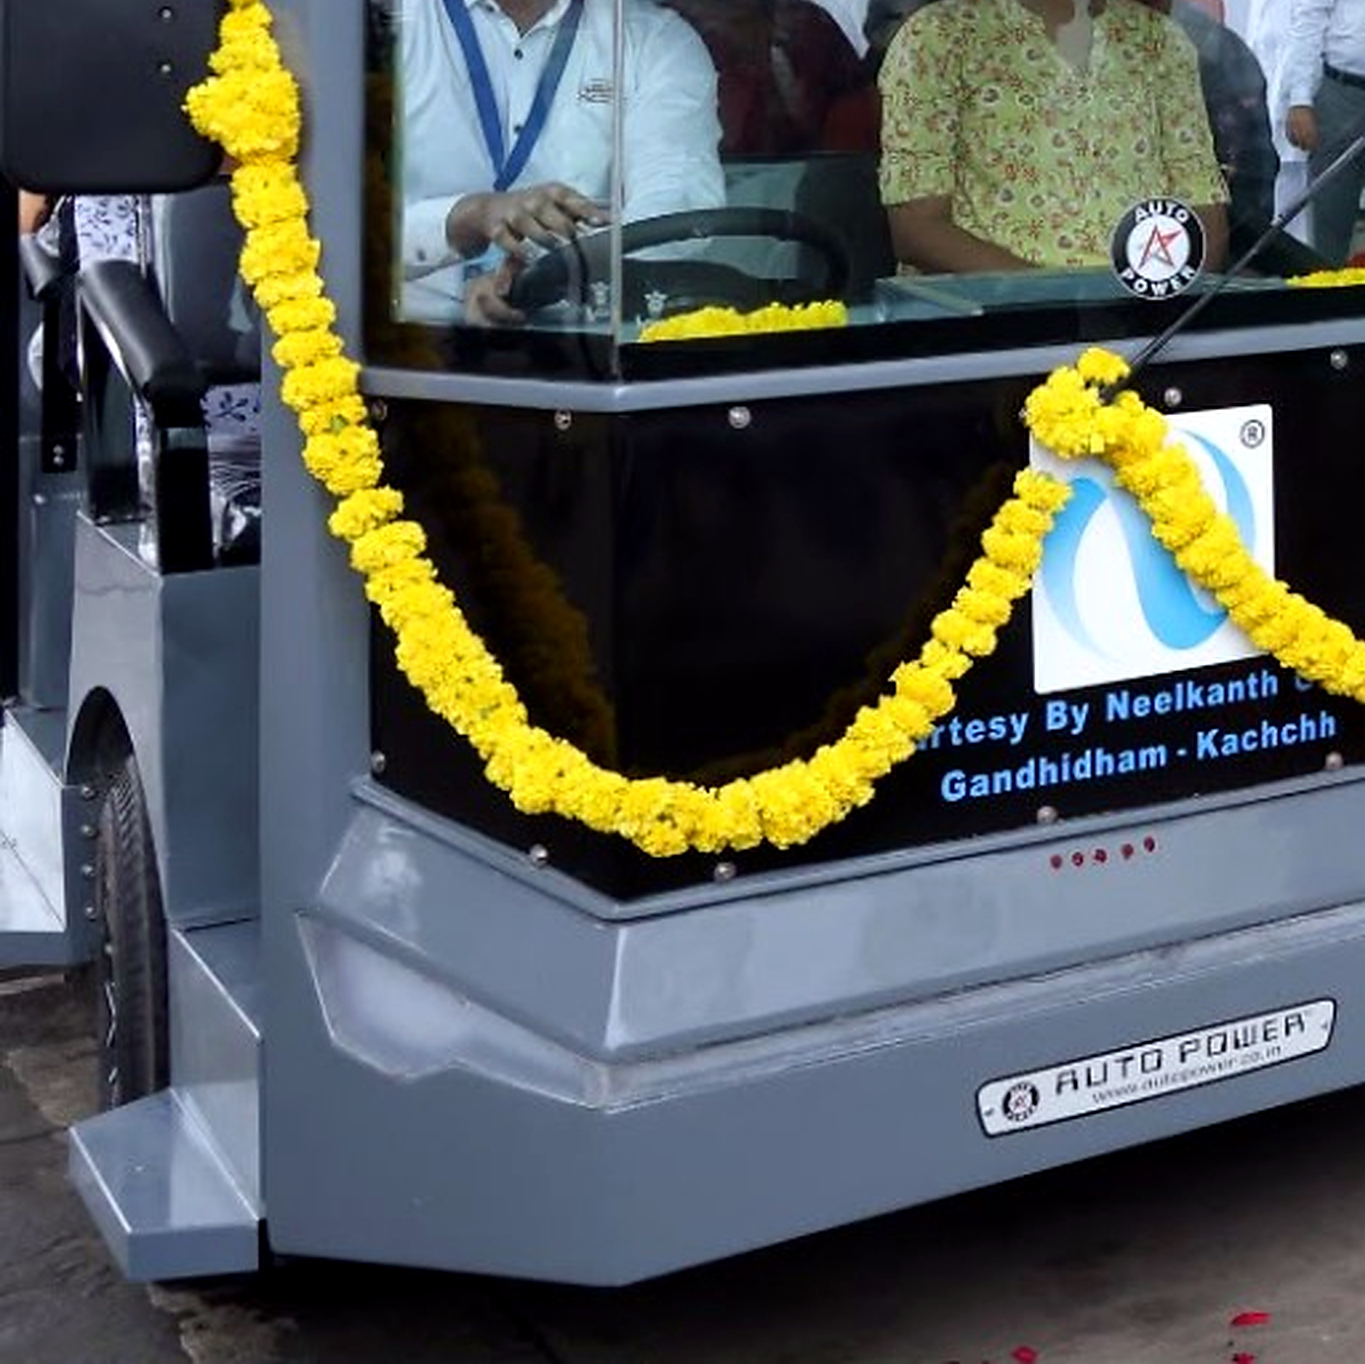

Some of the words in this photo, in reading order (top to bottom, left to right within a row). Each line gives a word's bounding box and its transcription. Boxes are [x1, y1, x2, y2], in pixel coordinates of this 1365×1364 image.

[1135, 200, 1189, 223] AUTO
[1121, 266, 1196, 296] POWER
[918, 712, 1029, 750] rtesy
[1046, 700, 1089, 734] By
[1106, 669, 1279, 722] Neelkanth
[941, 740, 1167, 802] Gandhidham
[1197, 710, 1337, 760] Kachchh
[1055, 1047, 1164, 1096] AUTO
[1178, 1013, 1305, 1064] POWER
